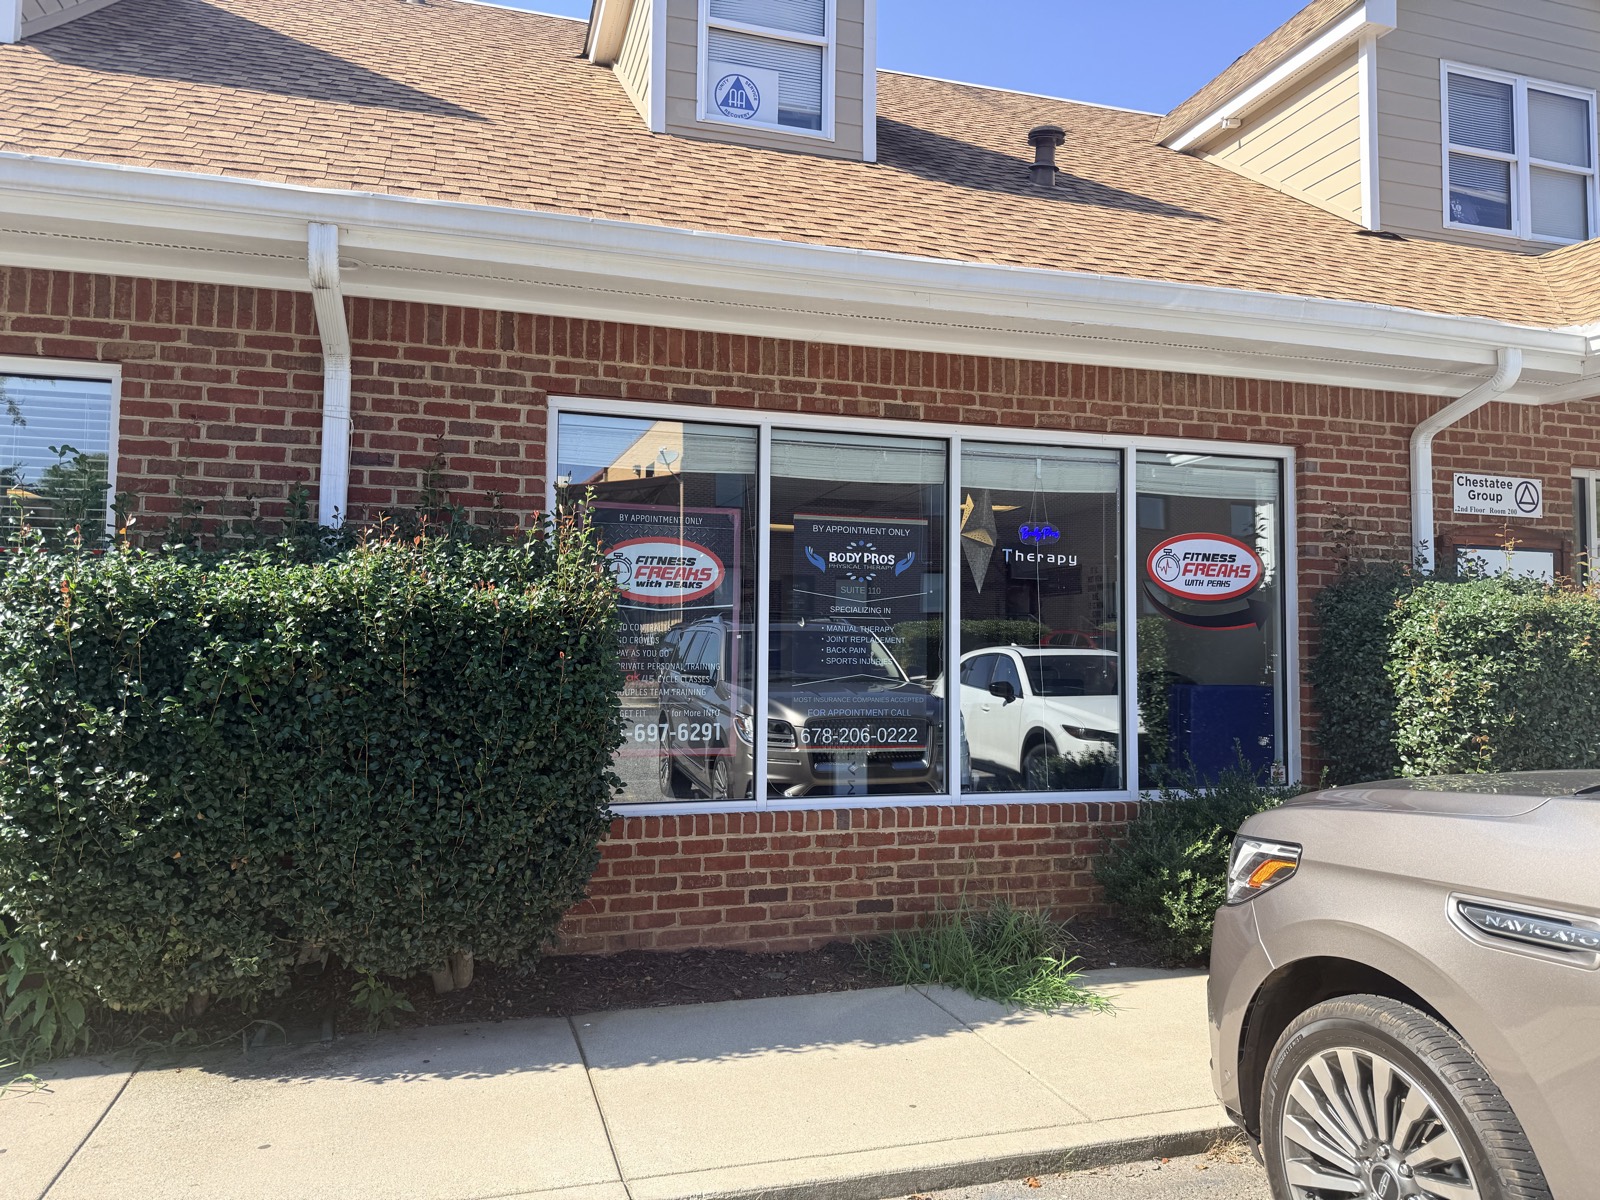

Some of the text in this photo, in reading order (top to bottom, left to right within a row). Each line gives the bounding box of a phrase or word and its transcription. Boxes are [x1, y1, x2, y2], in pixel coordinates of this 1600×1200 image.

[718, 78, 729, 90] UNITY
[744, 80, 757, 101] SERVICE
[728, 88, 746, 108] AA
[724, 108, 750, 118] RECOVERY
[1456, 476, 1513, 490] Chestatee
[1468, 490, 1502, 503] Group
[619, 514, 703, 525] BY APPOINTMENT ONLY
[826, 526, 886, 535] APPOINTMENT
[888, 528, 910, 536] ONLY
[635, 556, 697, 566] FITNESS
[829, 552, 895, 565] BODY PROS
[1002, 548, 1077, 566] Therapy
[1182, 552, 1236, 563] FITNESS
[634, 566, 712, 581] FREAKS
[1182, 563, 1251, 578] FREAKS
[636, 580, 703, 589] with PEAKS
[1185, 579, 1231, 588] WITH PEAKS
[840, 586, 881, 595] SUITE 110
[830, 606, 882, 614] SPECIALIZING
[850, 636, 906, 644] REPLACEMENT
[859, 658, 893, 666] INJURIES
[671, 688, 707, 696] TRAINING
[828, 709, 888, 717] APPOINTMENT
[890, 709, 911, 717] CALL
[801, 728, 918, 743] 678-206-0222
